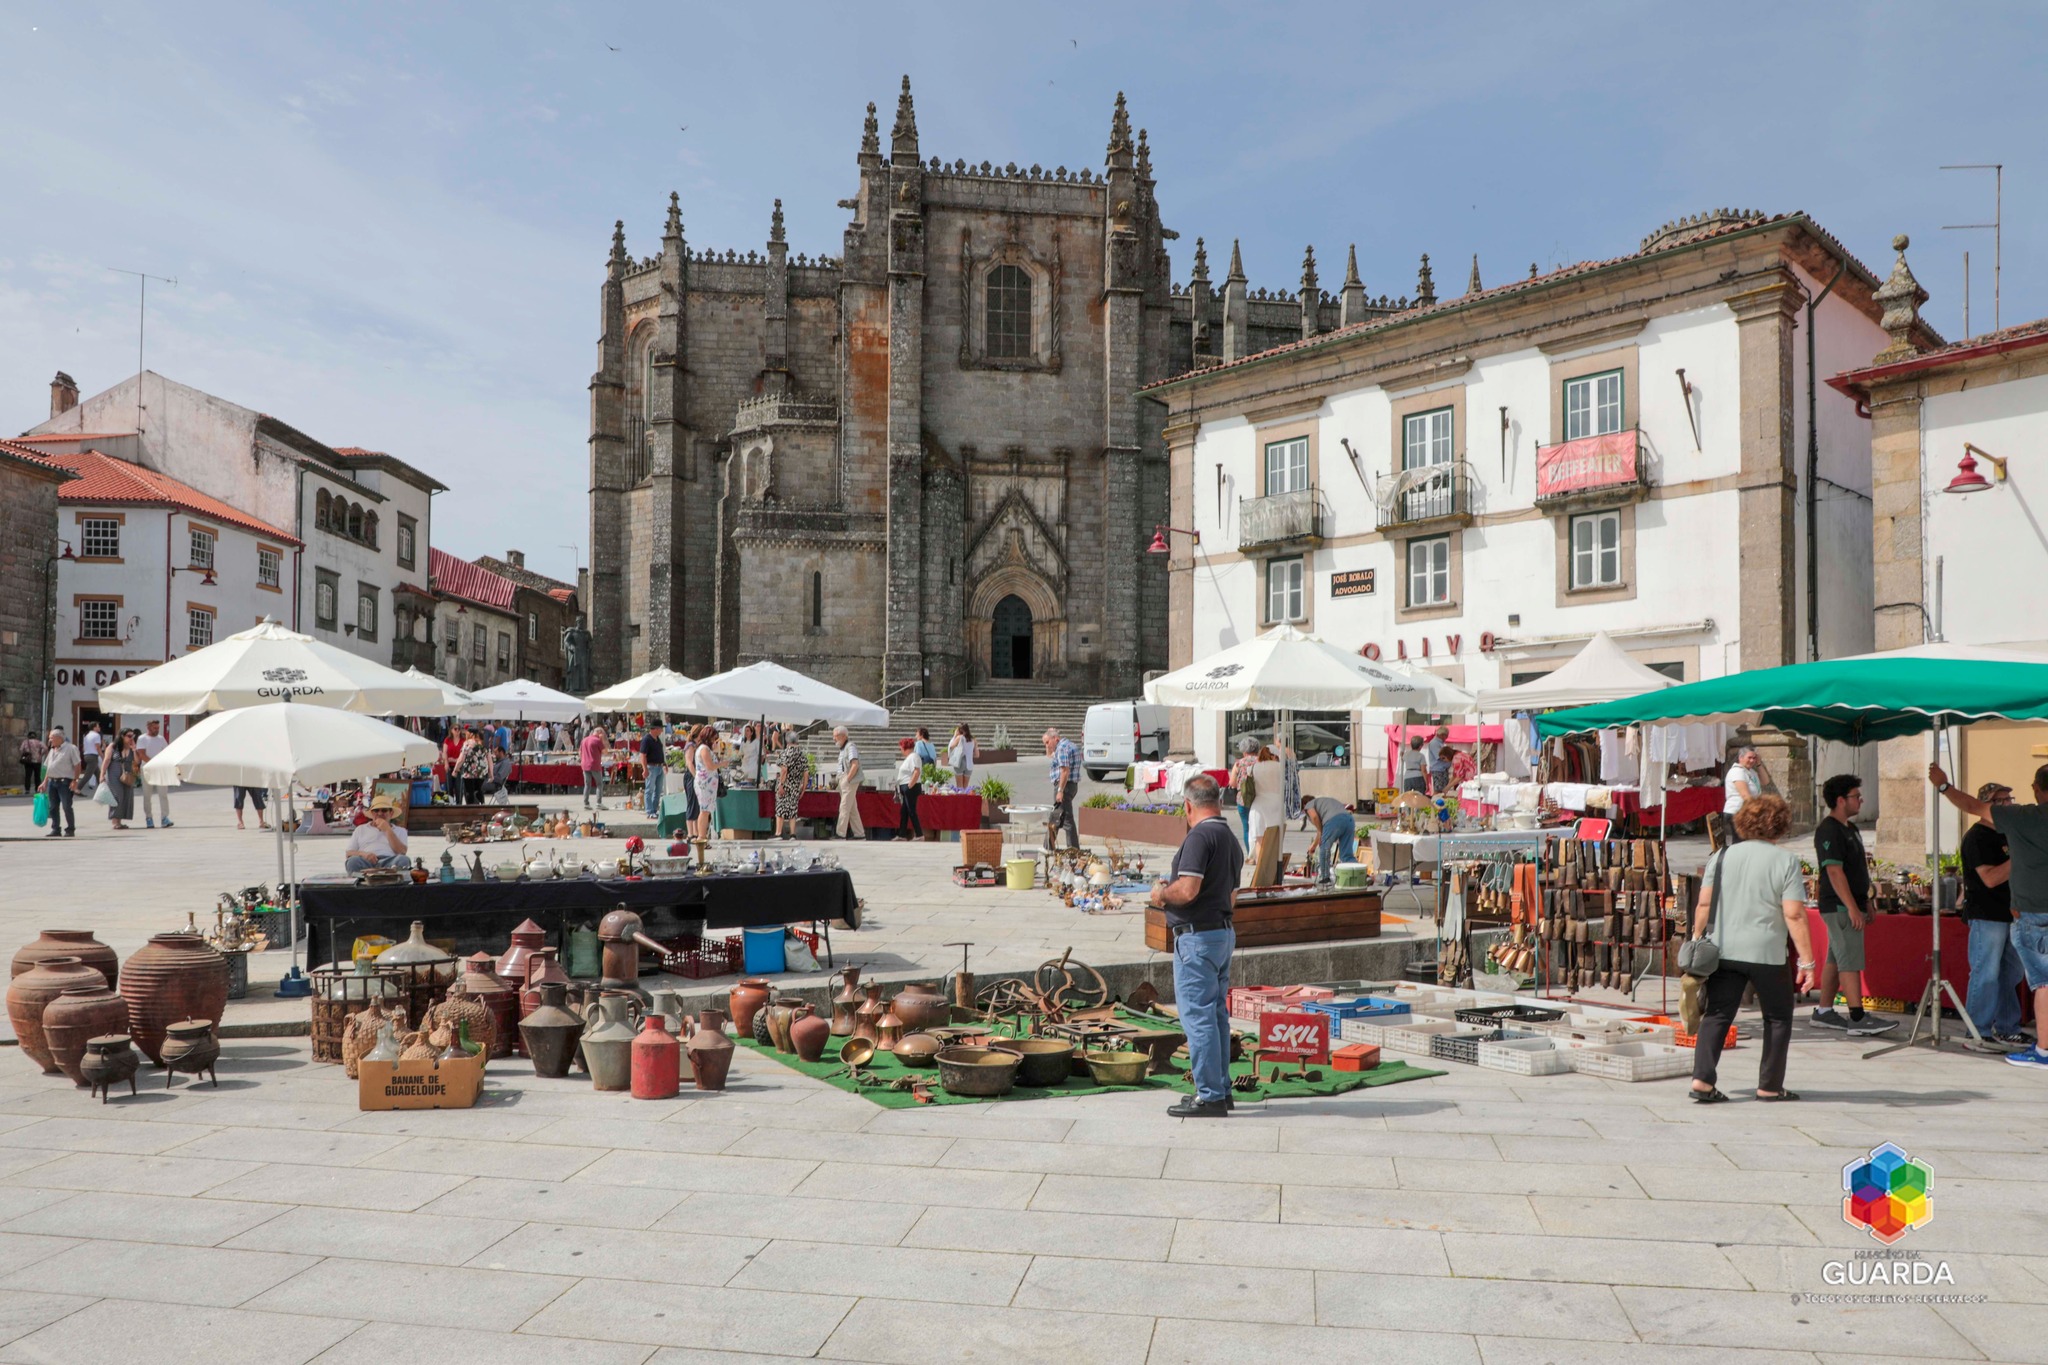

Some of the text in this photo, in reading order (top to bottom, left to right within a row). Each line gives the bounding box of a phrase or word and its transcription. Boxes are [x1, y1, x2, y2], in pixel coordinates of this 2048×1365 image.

[1548, 454, 1624, 485] BEEFEATER
[1333, 571, 1374, 585] JOSÉ ROBALO
[1335, 584, 1372, 595] ADVOGADO
[57, 669, 86, 686] OM
[1185, 682, 1229, 690] GUARDA
[1267, 1023, 1319, 1047] SKIL
[391, 1075, 440, 1085] BANANE DE
[385, 1084, 446, 1096] GUADELOUPE
